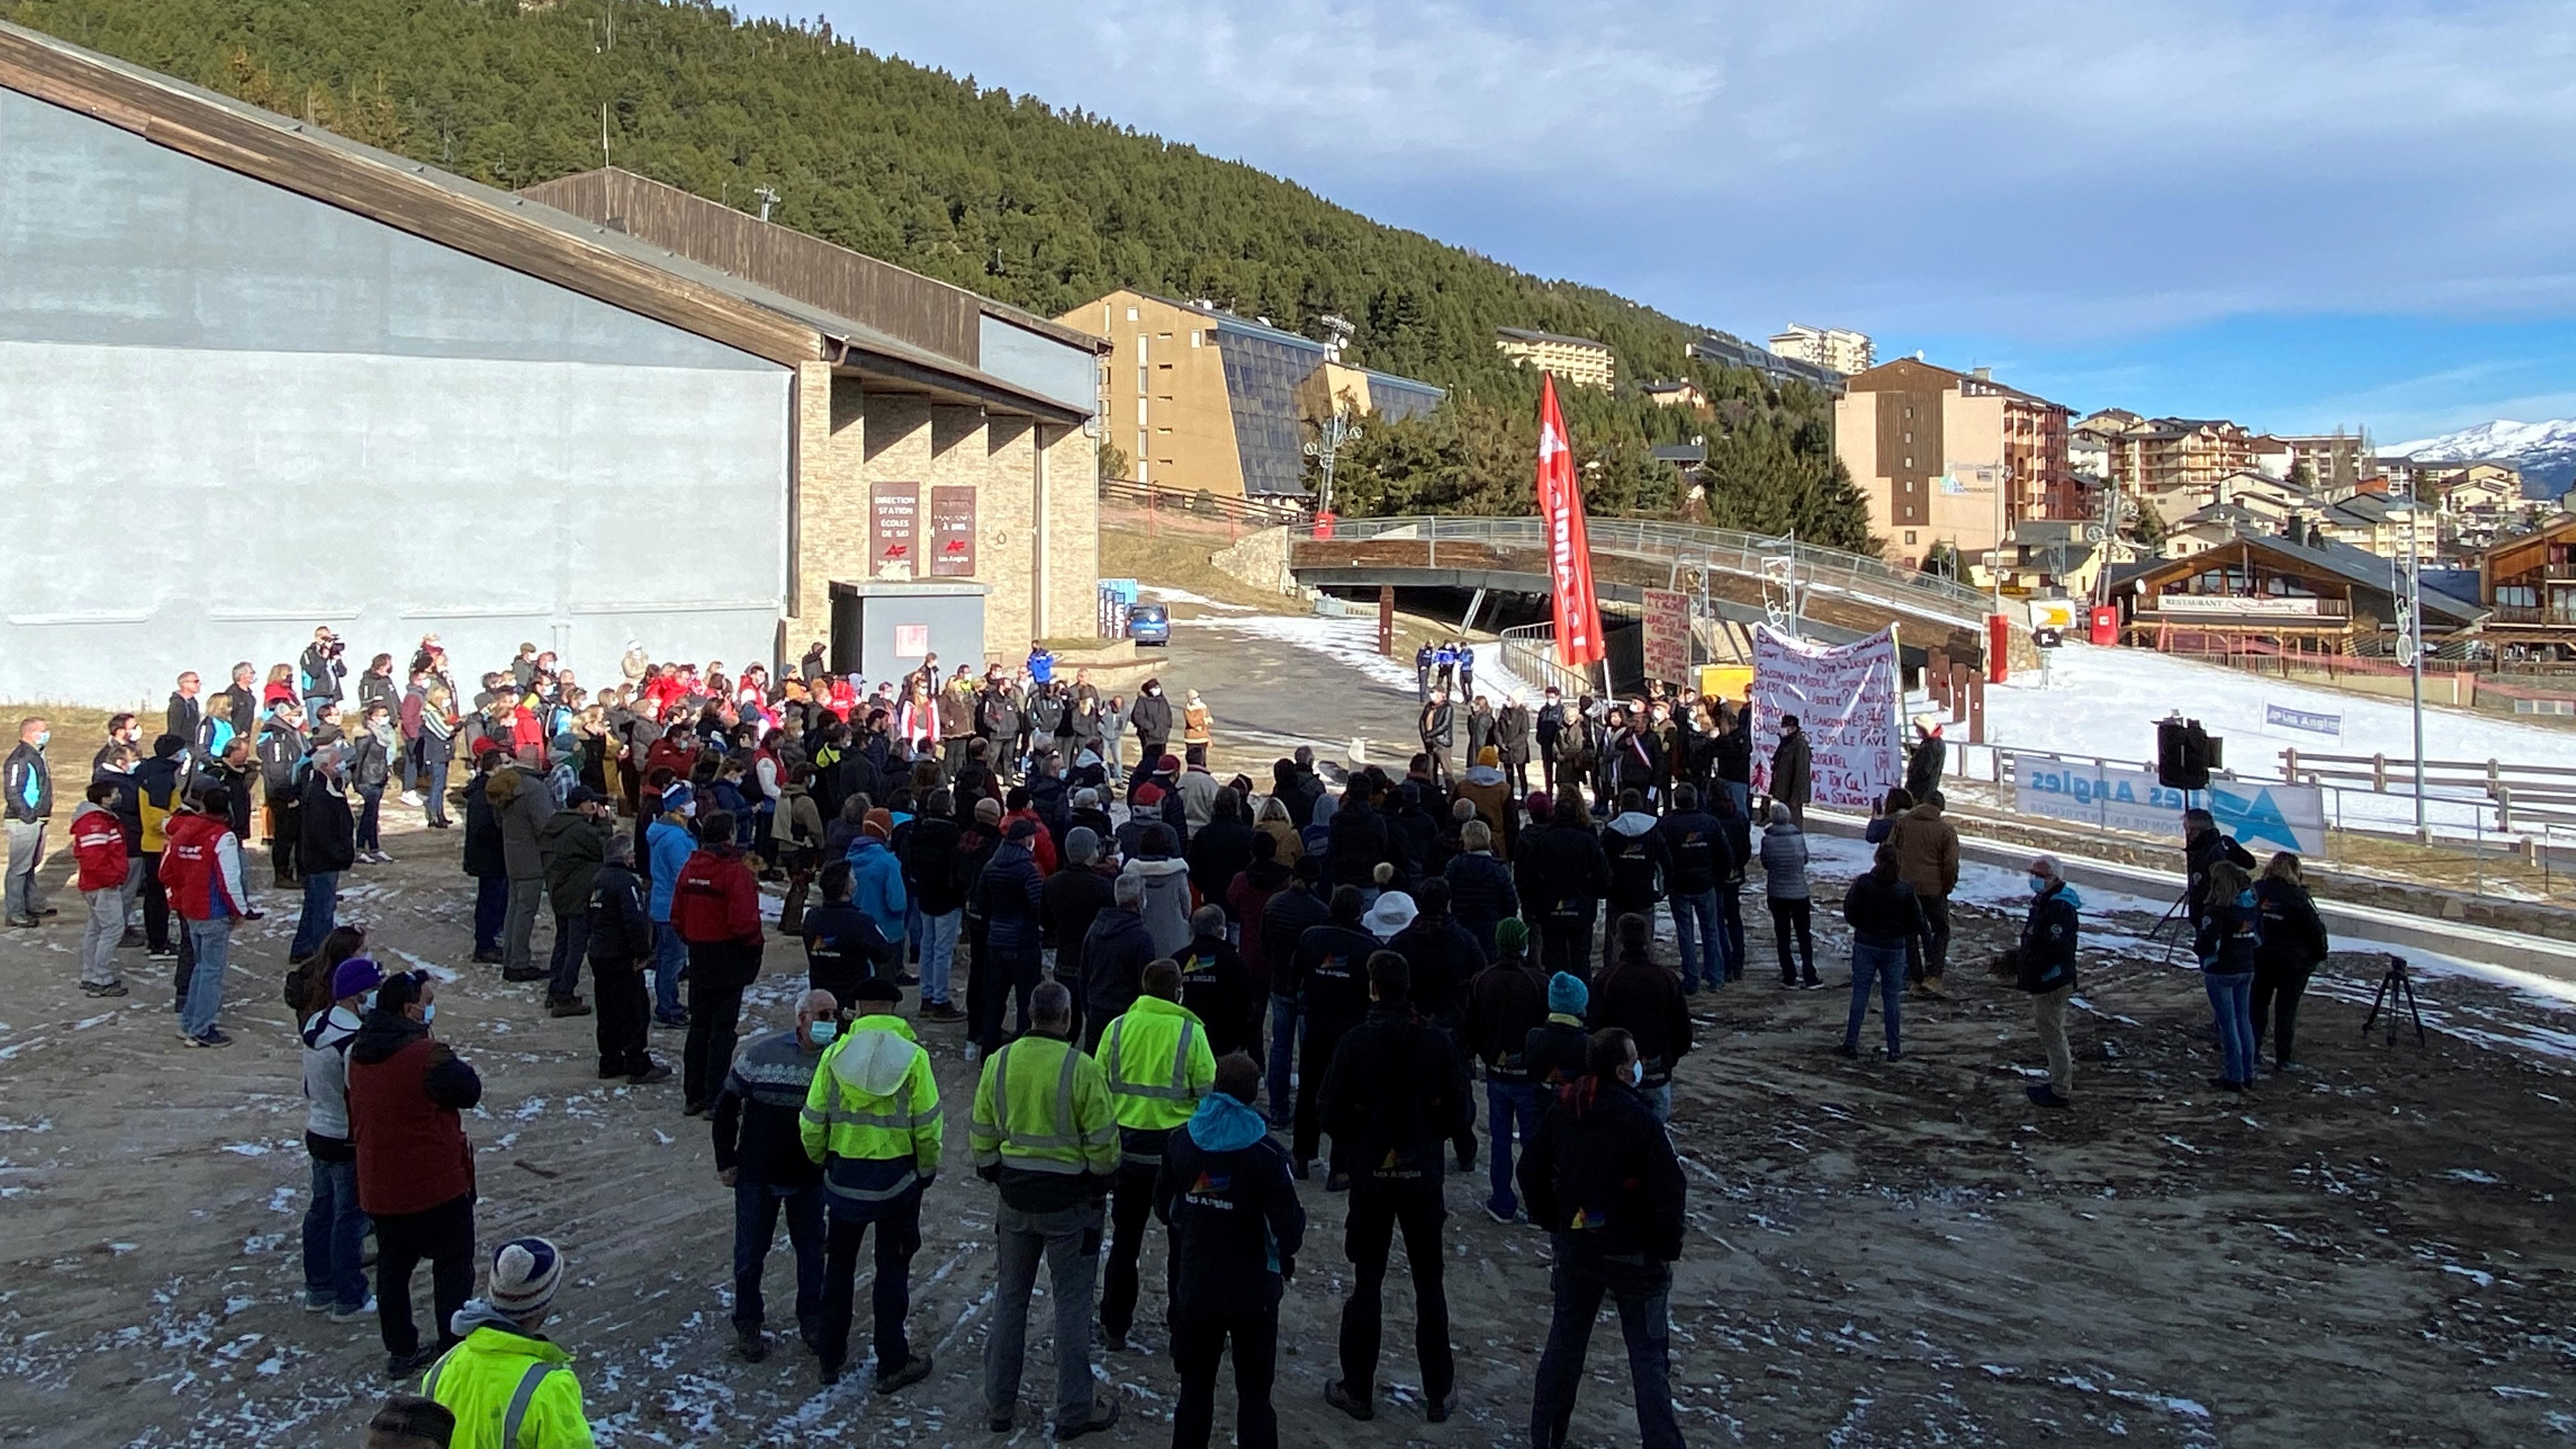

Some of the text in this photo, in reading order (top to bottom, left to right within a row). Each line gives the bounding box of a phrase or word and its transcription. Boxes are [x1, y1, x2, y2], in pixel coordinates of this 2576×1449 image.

[874, 496, 916, 505] DIRECTION
[878, 507, 914, 515] STATION
[2165, 598, 2223, 608] RESTAURANT
[1816, 729, 1839, 746] SUR
[1841, 730, 1855, 747] LE
